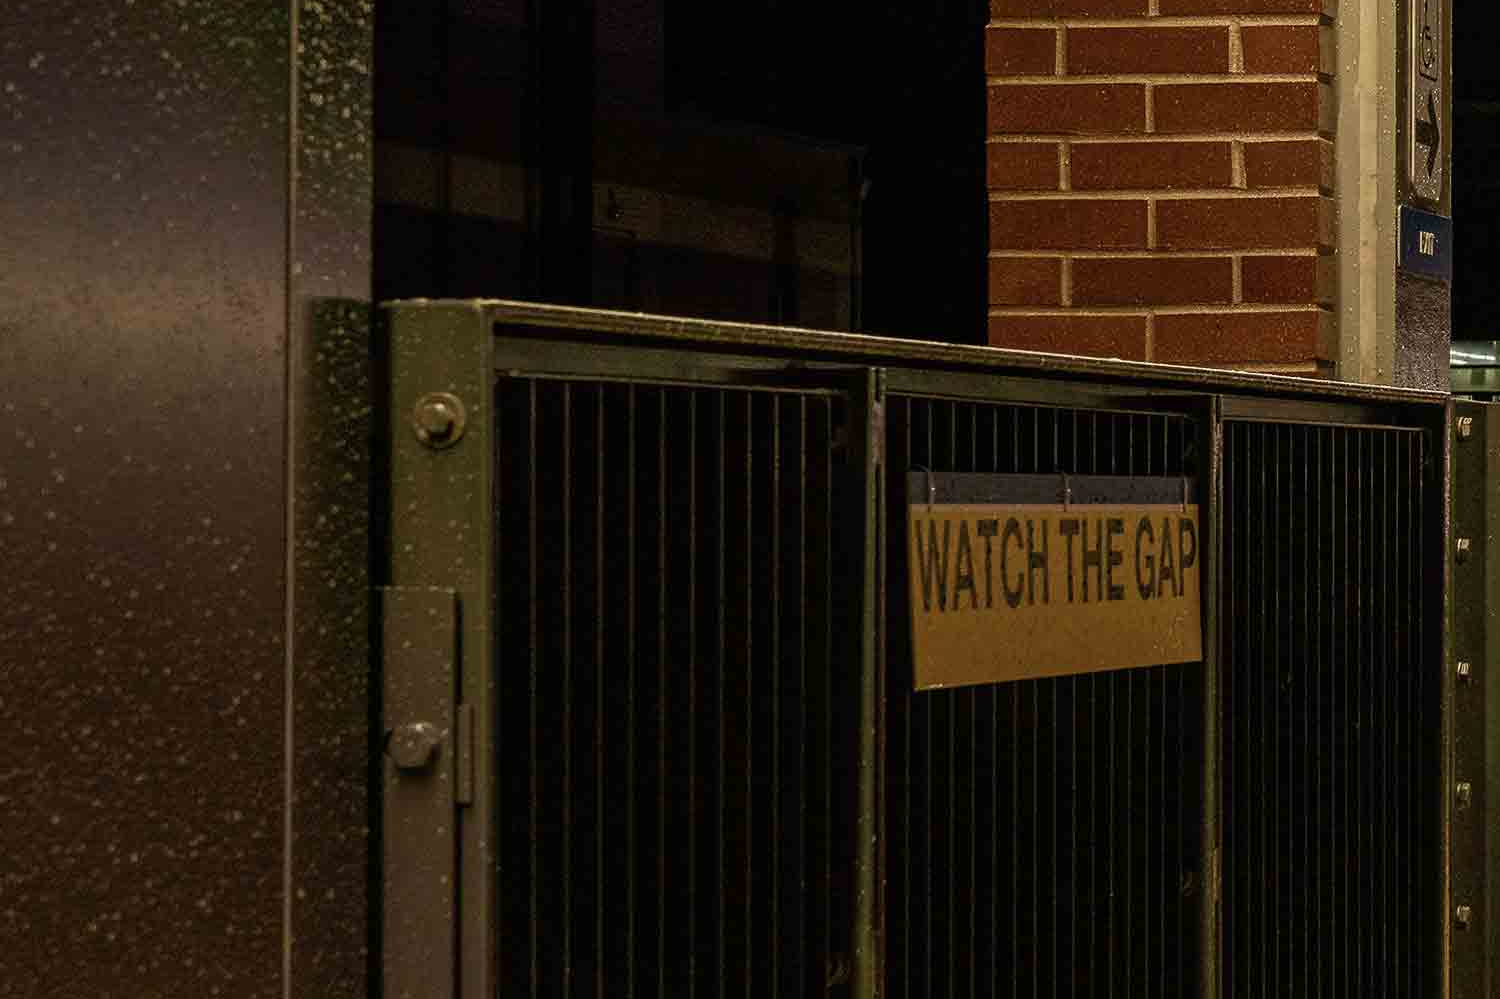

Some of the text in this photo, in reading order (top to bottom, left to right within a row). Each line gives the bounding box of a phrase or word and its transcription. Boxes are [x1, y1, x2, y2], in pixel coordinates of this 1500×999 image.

[915, 514, 1197, 612] WATCH THE GAP
